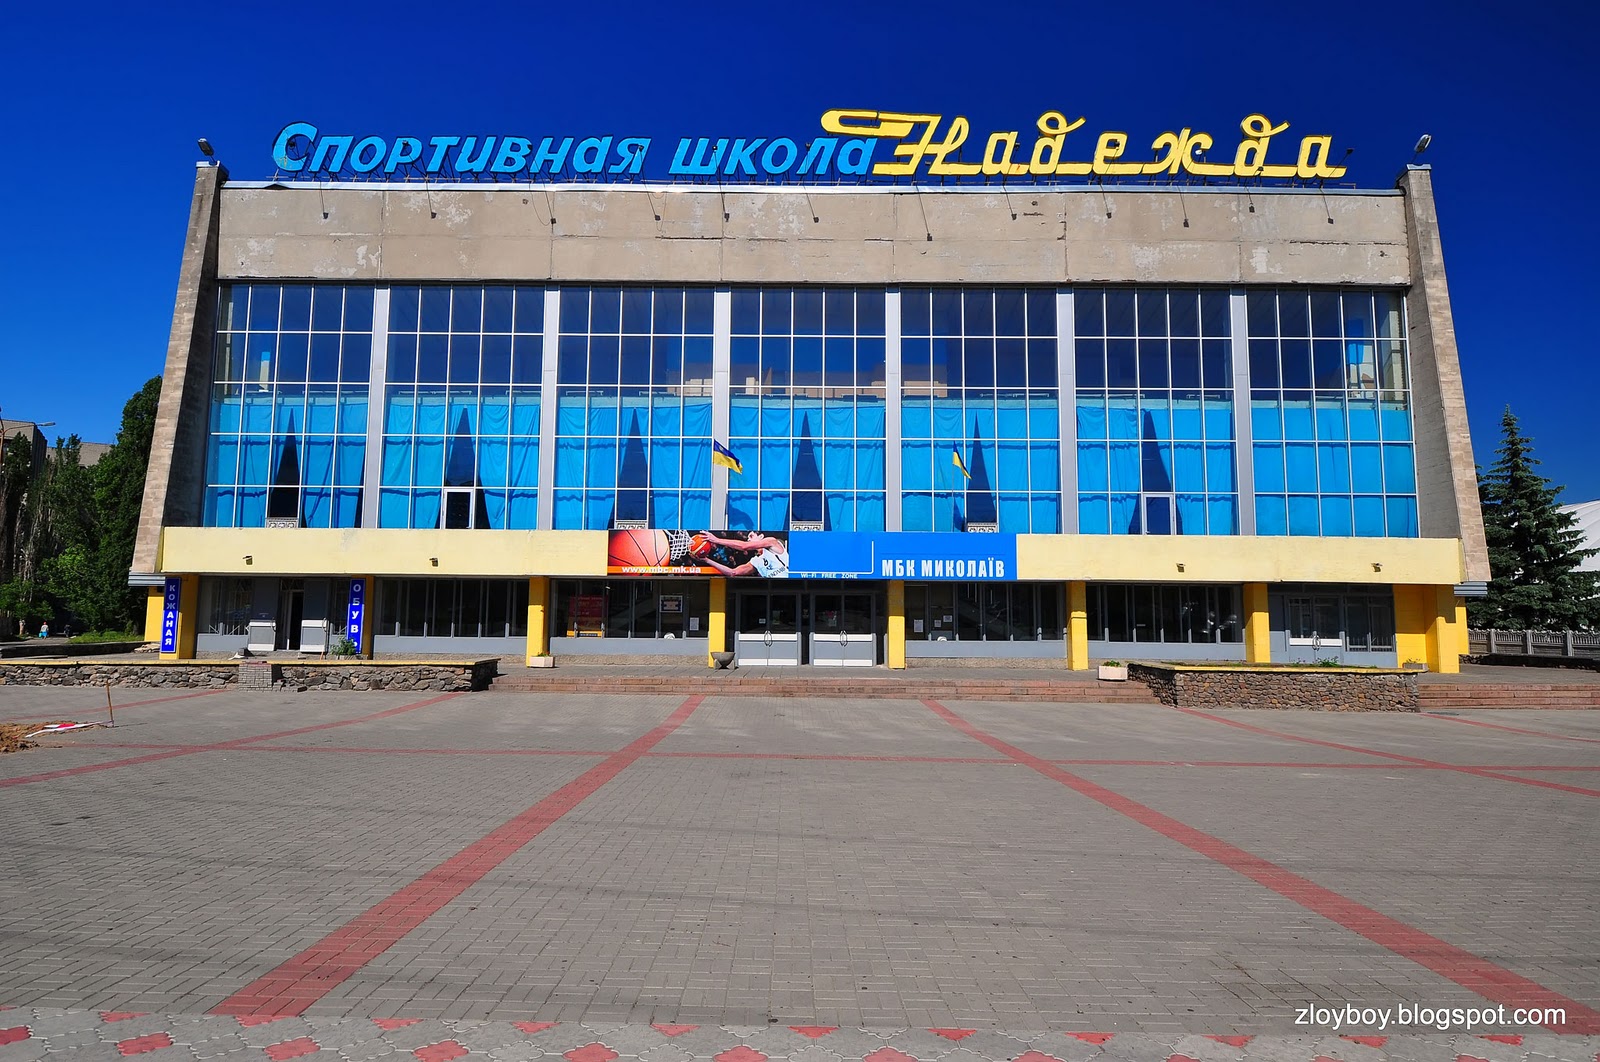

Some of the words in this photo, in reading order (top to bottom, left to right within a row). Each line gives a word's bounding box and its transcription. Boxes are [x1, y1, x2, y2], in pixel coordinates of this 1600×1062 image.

[821, 108, 1346, 178] Надежда
[621, 565, 702, 574] www.mbc.mk.ua
[881, 559, 916, 577] МБК
[921, 557, 1005, 578] МИКОЛАЇВ
[164, 584, 176, 646] КОЖАНАЯ
